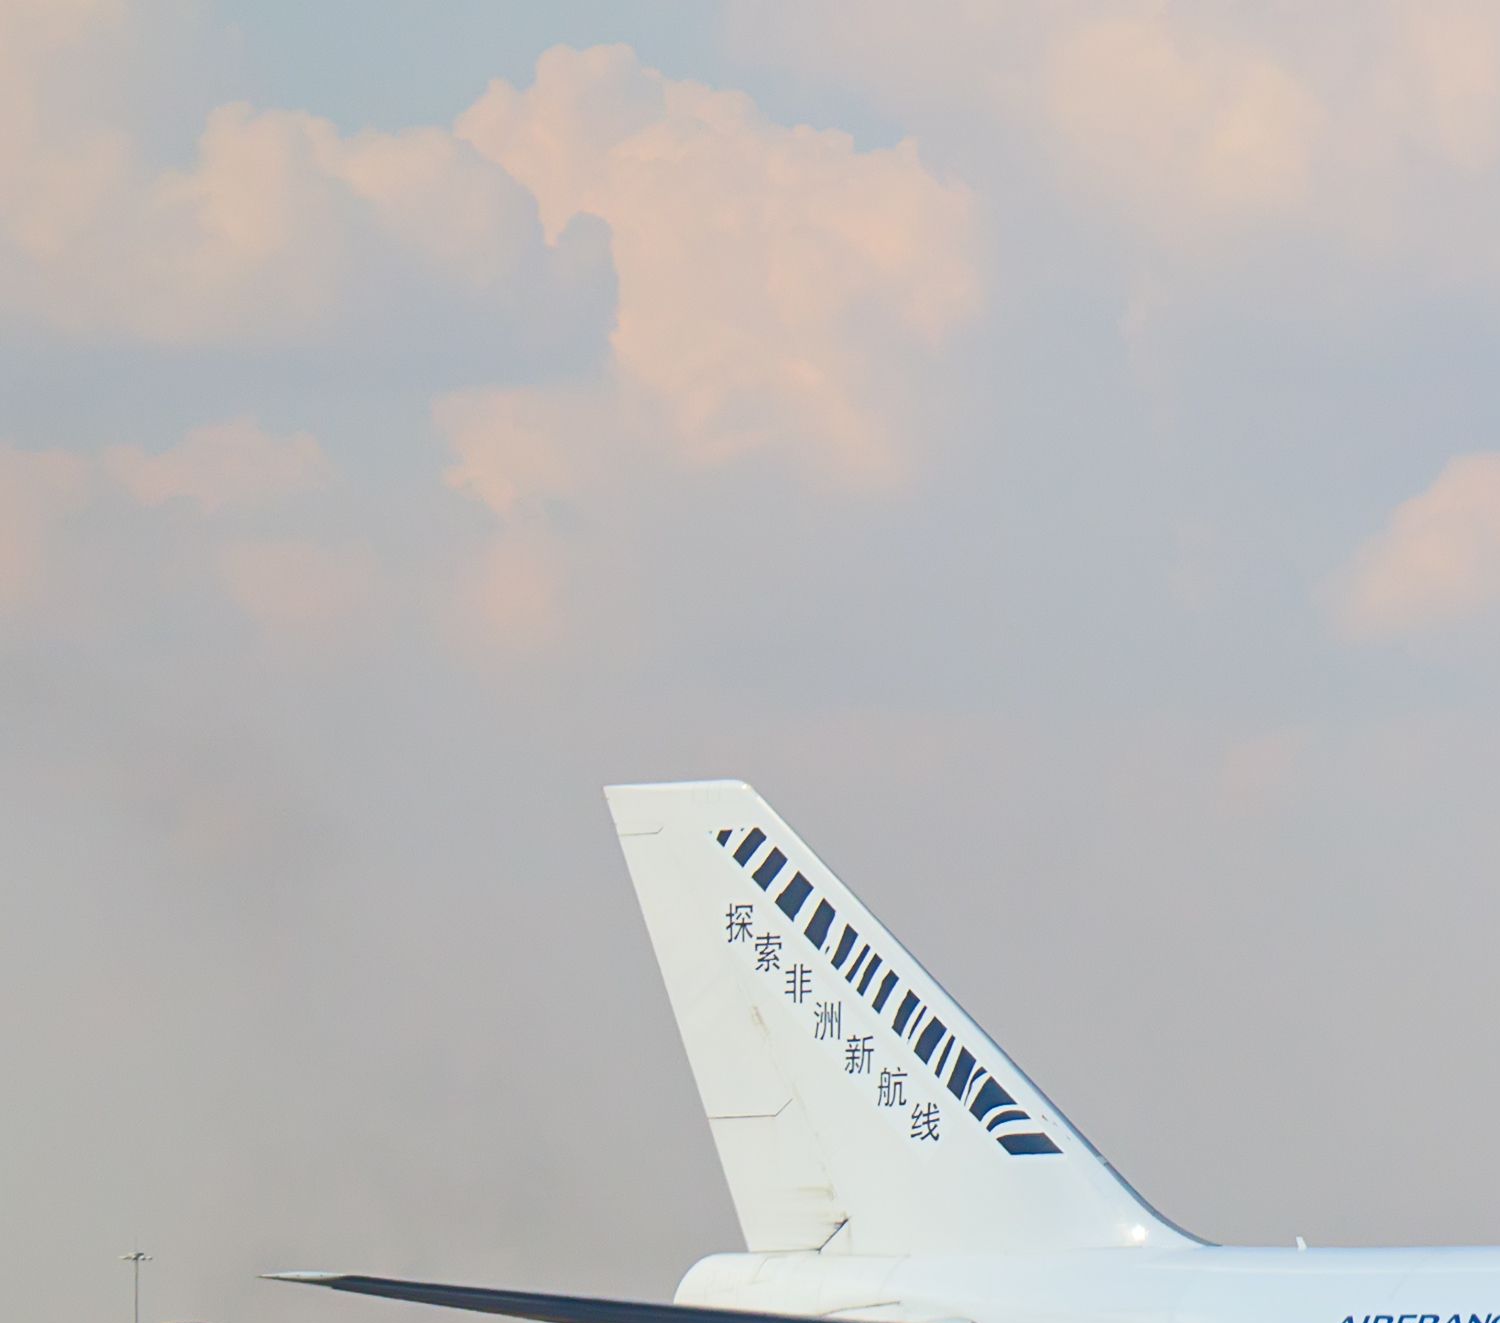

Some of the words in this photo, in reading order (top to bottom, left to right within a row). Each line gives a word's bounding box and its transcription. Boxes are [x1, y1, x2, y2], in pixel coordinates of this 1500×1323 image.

[725, 903, 941, 1142] 探索非洲新航线
